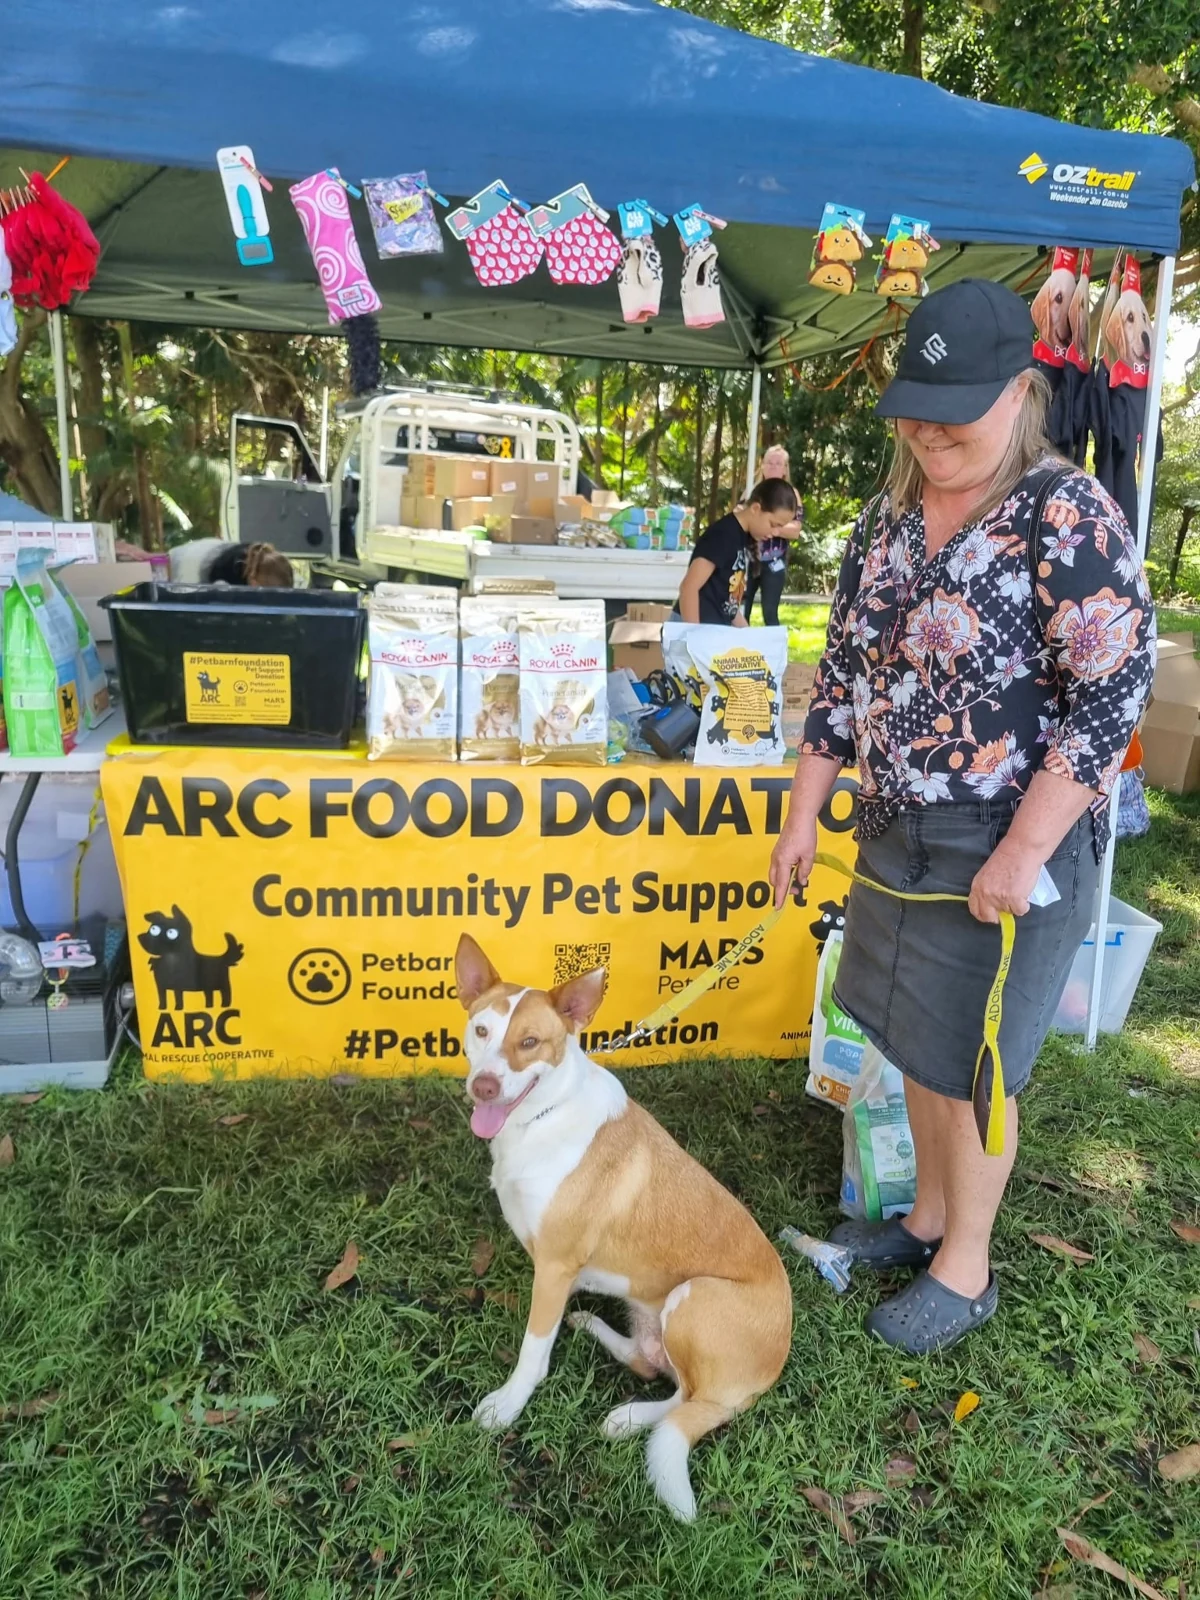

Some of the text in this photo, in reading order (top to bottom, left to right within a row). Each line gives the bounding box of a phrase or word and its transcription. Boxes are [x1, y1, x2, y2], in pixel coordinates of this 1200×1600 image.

[1050, 192, 1128, 209] Weekender 3m Gazebo
[189, 656, 285, 667] #Petbarnfoundation
[381, 652, 448, 663] ROYAL CANIN
[529, 659, 561, 669] ROYAL
[564, 658, 597, 669] CANIN
[258, 666, 285, 674] Support
[200, 694, 221, 704] ARC
[123, 775, 293, 839] ARC
[309, 777, 524, 839] FOOD
[252, 871, 809, 929] Community Pet Suppot
[714, 924, 766, 973] ADOPT ME
[362, 952, 453, 972] Petbar
[988, 953, 1010, 1023] ADOPT ME
[151, 1008, 242, 1048] ARC
[162, 1053, 201, 1063] RESCUE
[202, 1048, 275, 1062] COOPERATIVE
